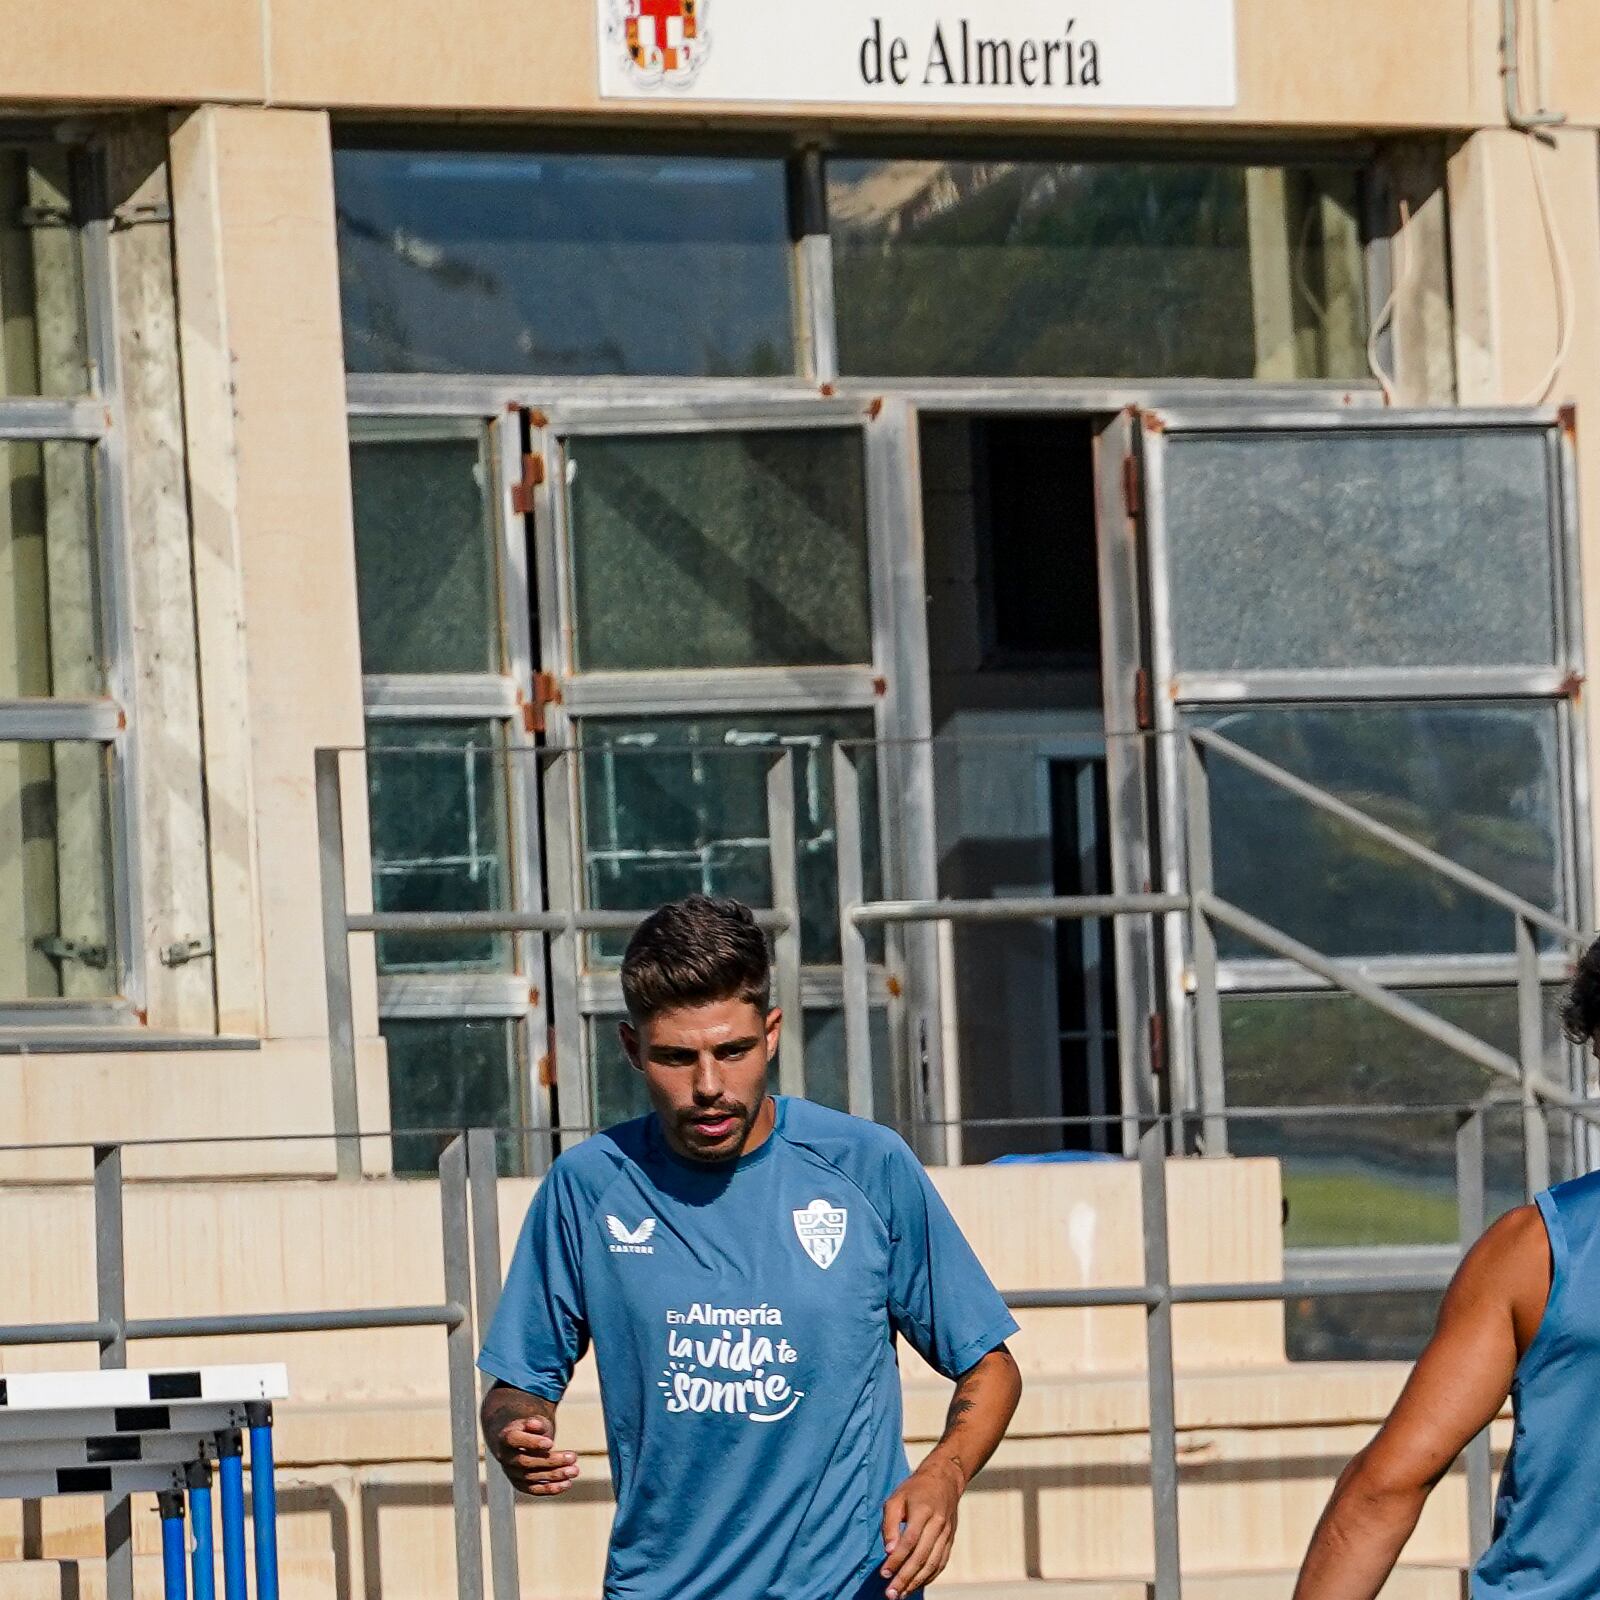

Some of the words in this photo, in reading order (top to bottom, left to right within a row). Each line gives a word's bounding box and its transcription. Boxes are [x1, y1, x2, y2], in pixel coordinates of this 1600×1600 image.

[860, 19, 909, 87] de
[921, 17, 1102, 88] Almería
[666, 1310, 686, 1325] En
[686, 1302, 783, 1326] Almería
[667, 1329, 692, 1359] la
[691, 1328, 775, 1373] vida
[775, 1340, 799, 1364] te
